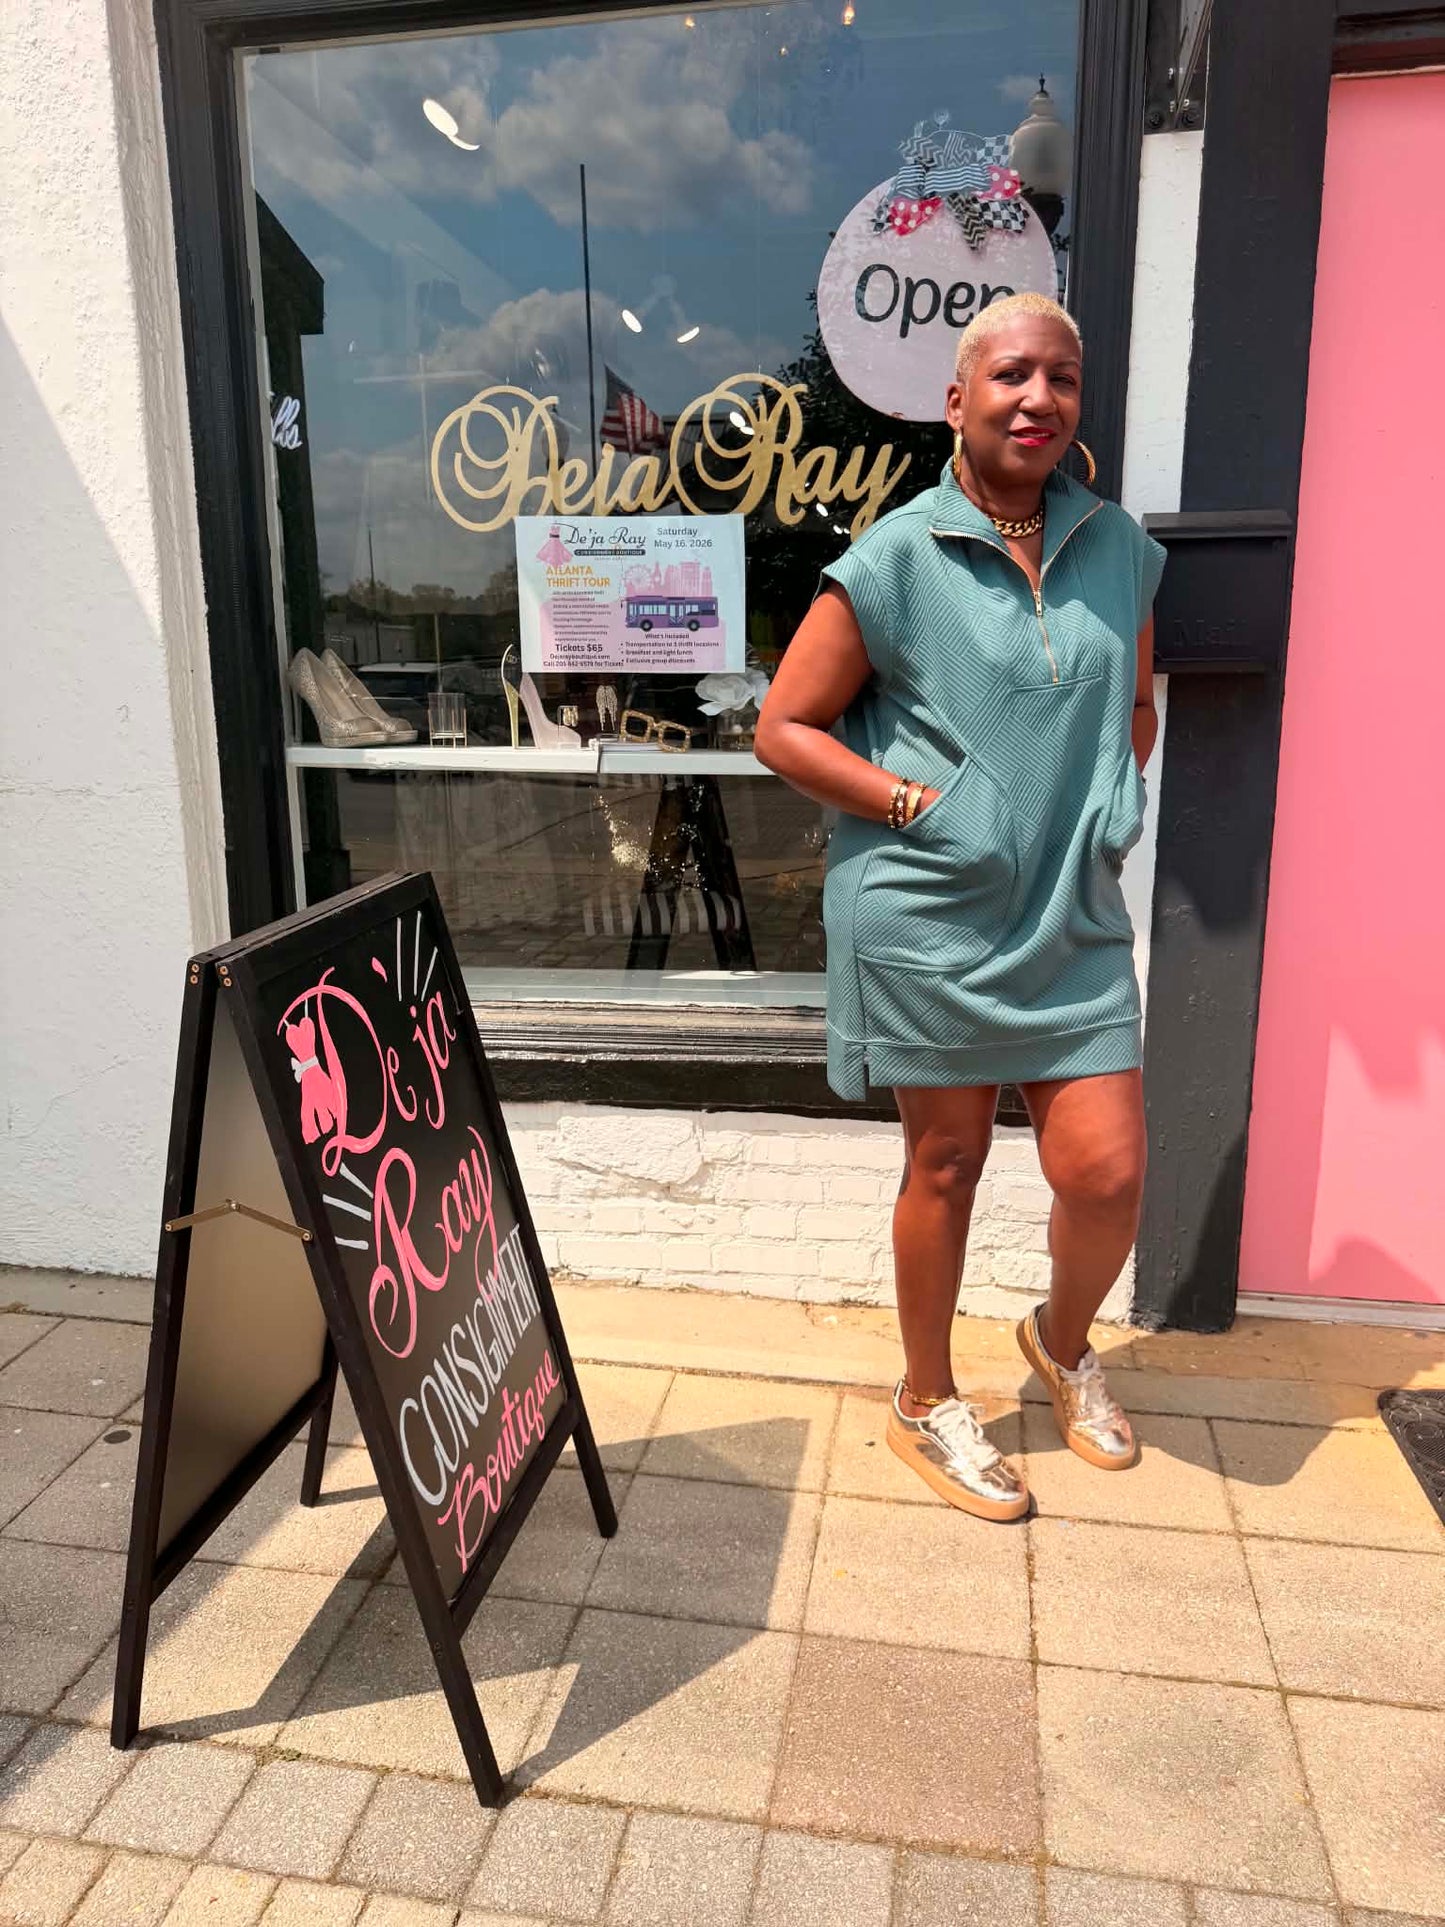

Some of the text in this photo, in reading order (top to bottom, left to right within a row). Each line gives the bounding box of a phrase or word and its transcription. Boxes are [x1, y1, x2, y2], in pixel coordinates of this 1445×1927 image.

[670, 373, 912, 542] Ray
[561, 525, 646, 548] De'ja Ray
[657, 527, 698, 538] Saturday
[654, 539, 673, 550] May
[690, 539, 713, 548] 2026
[546, 565, 593, 576] ATLANTA
[547, 577, 611, 588] THRIFT TOUR
[556, 644, 603, 652] Tickets $65
[369, 1126, 498, 1359] Ray
[399, 1223, 542, 1507] CONSIGNMENT
[436, 1348, 561, 1574] Boutique
